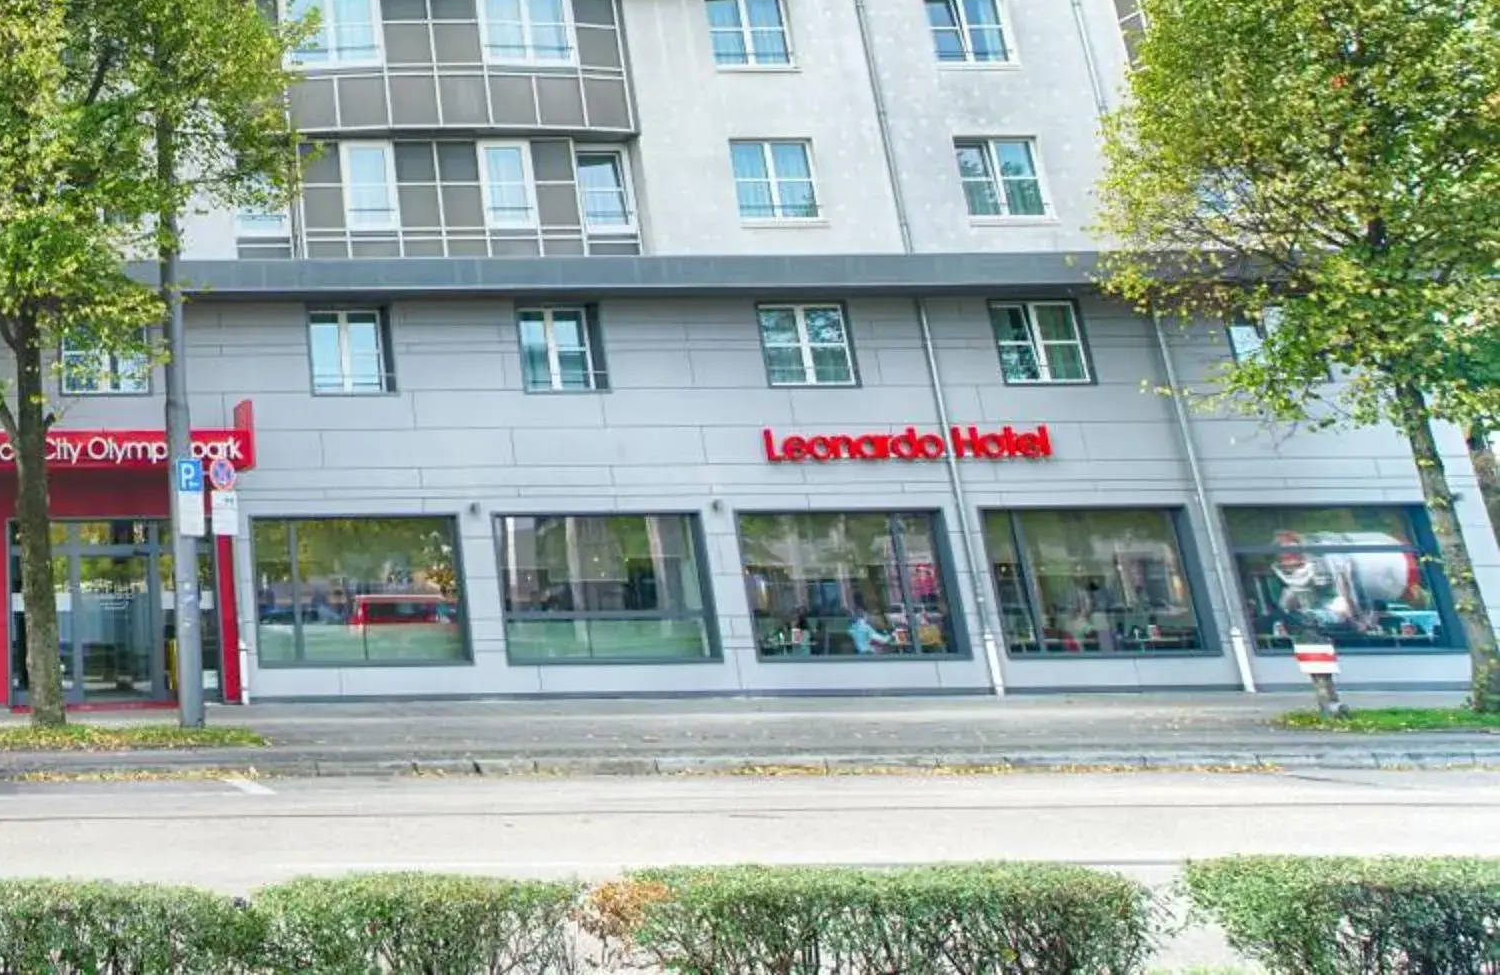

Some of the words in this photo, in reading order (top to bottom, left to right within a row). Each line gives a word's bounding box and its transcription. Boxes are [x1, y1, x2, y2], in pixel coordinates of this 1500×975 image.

[763, 427, 944, 462] Leonardo
[951, 425, 1052, 459] Hotel
[181, 463, 195, 489] P
